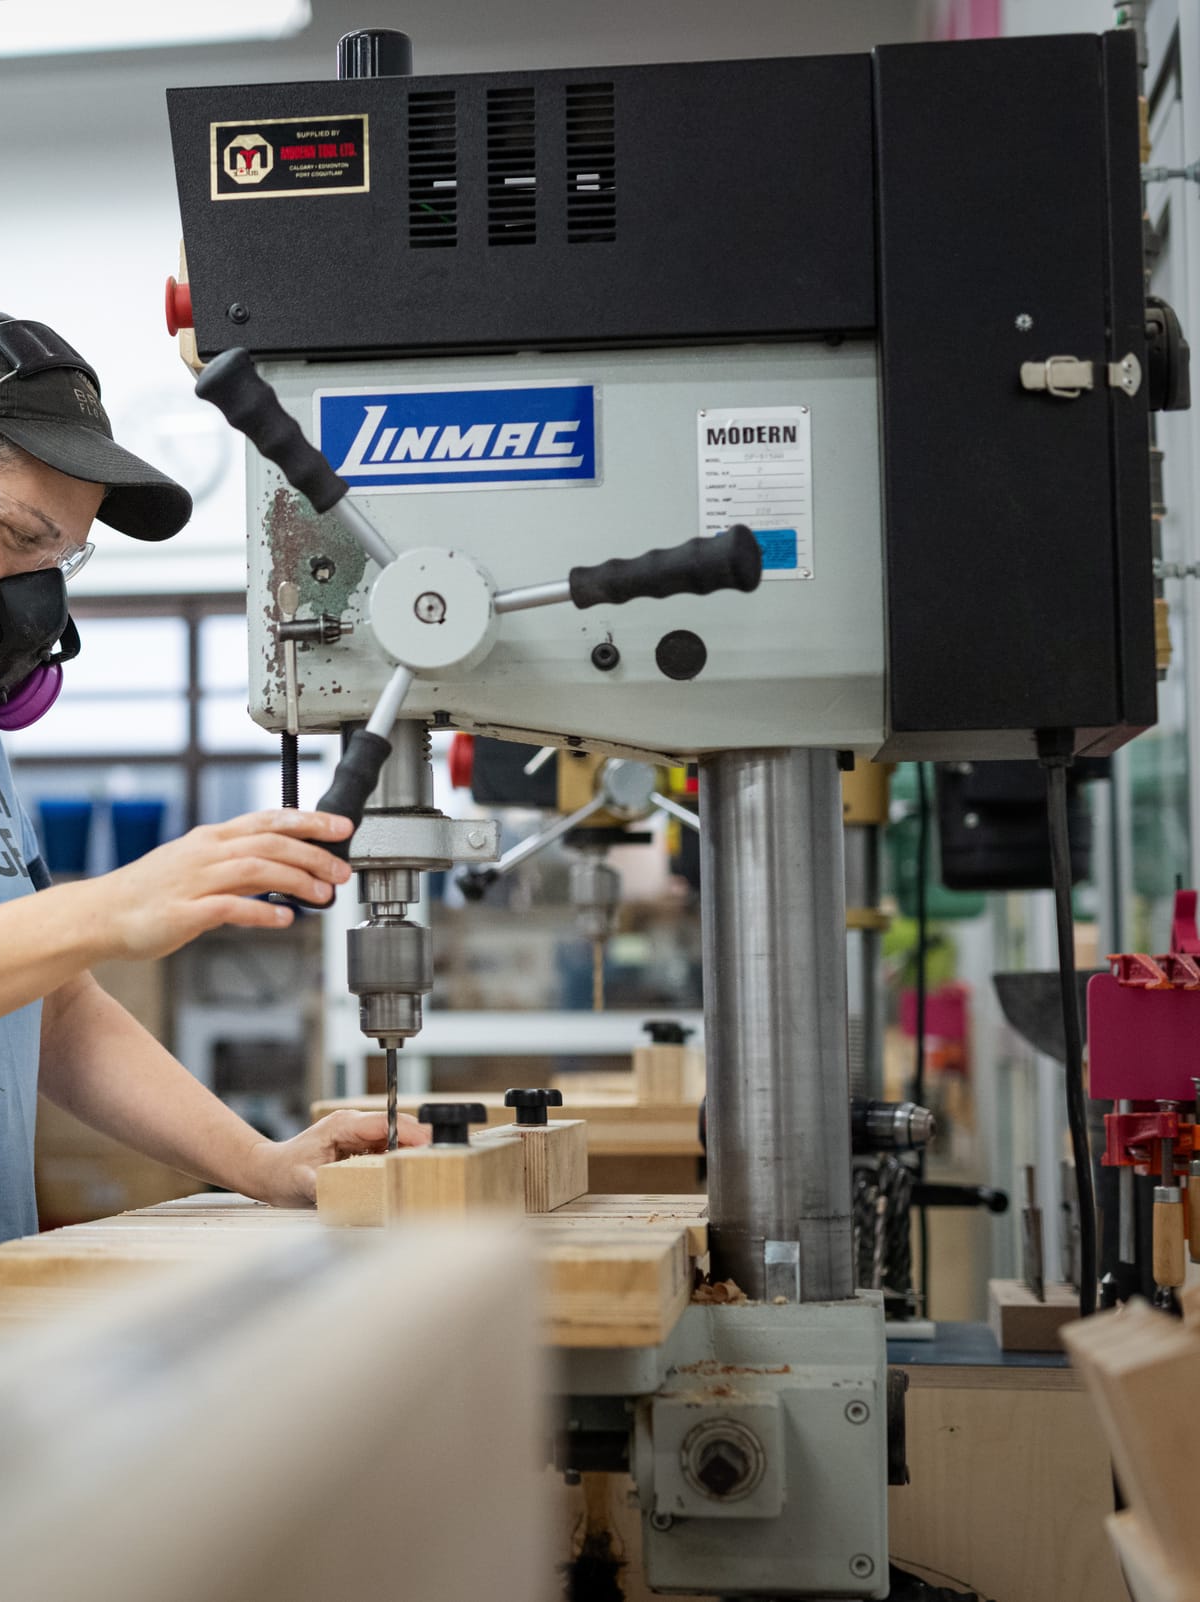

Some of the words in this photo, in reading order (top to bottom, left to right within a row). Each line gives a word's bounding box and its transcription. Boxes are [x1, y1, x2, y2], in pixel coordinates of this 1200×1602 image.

[296, 130, 330, 139] SUPPLIED
[331, 129, 341, 137] BY
[317, 143, 338, 158] TOOL
[318, 162, 350, 170] EDMONTON
[706, 425, 797, 446] MODERN
